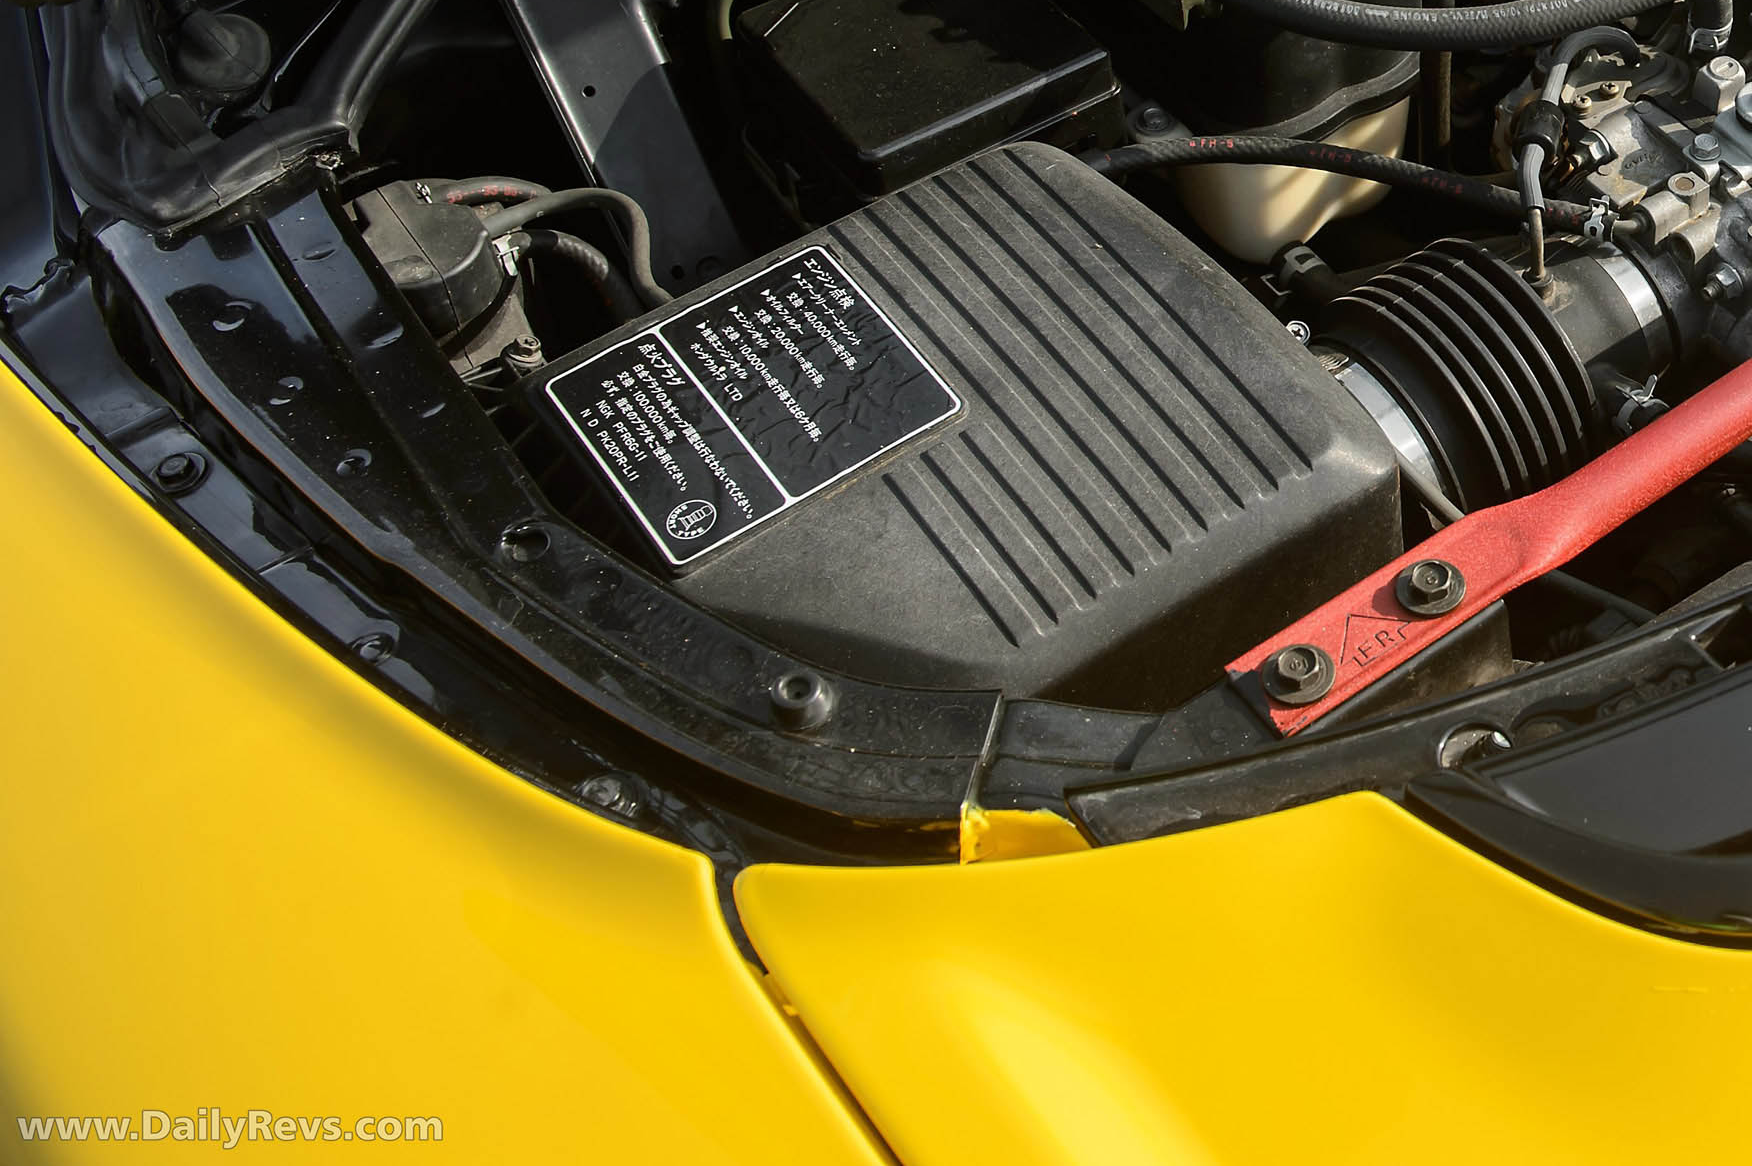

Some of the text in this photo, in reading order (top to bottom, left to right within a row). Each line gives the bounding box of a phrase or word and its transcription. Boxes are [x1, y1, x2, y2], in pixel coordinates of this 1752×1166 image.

[803, 258, 855, 310] エンジン点検
[733, 310, 770, 350] エンジンオイル
[637, 343, 686, 386] 点火プラグ
[724, 383, 743, 402] LTD
[596, 399, 648, 462] NGK PFR6G-11
[596, 430, 640, 482] PK20PR-L11
[1357, 630, 1395, 659] FR
